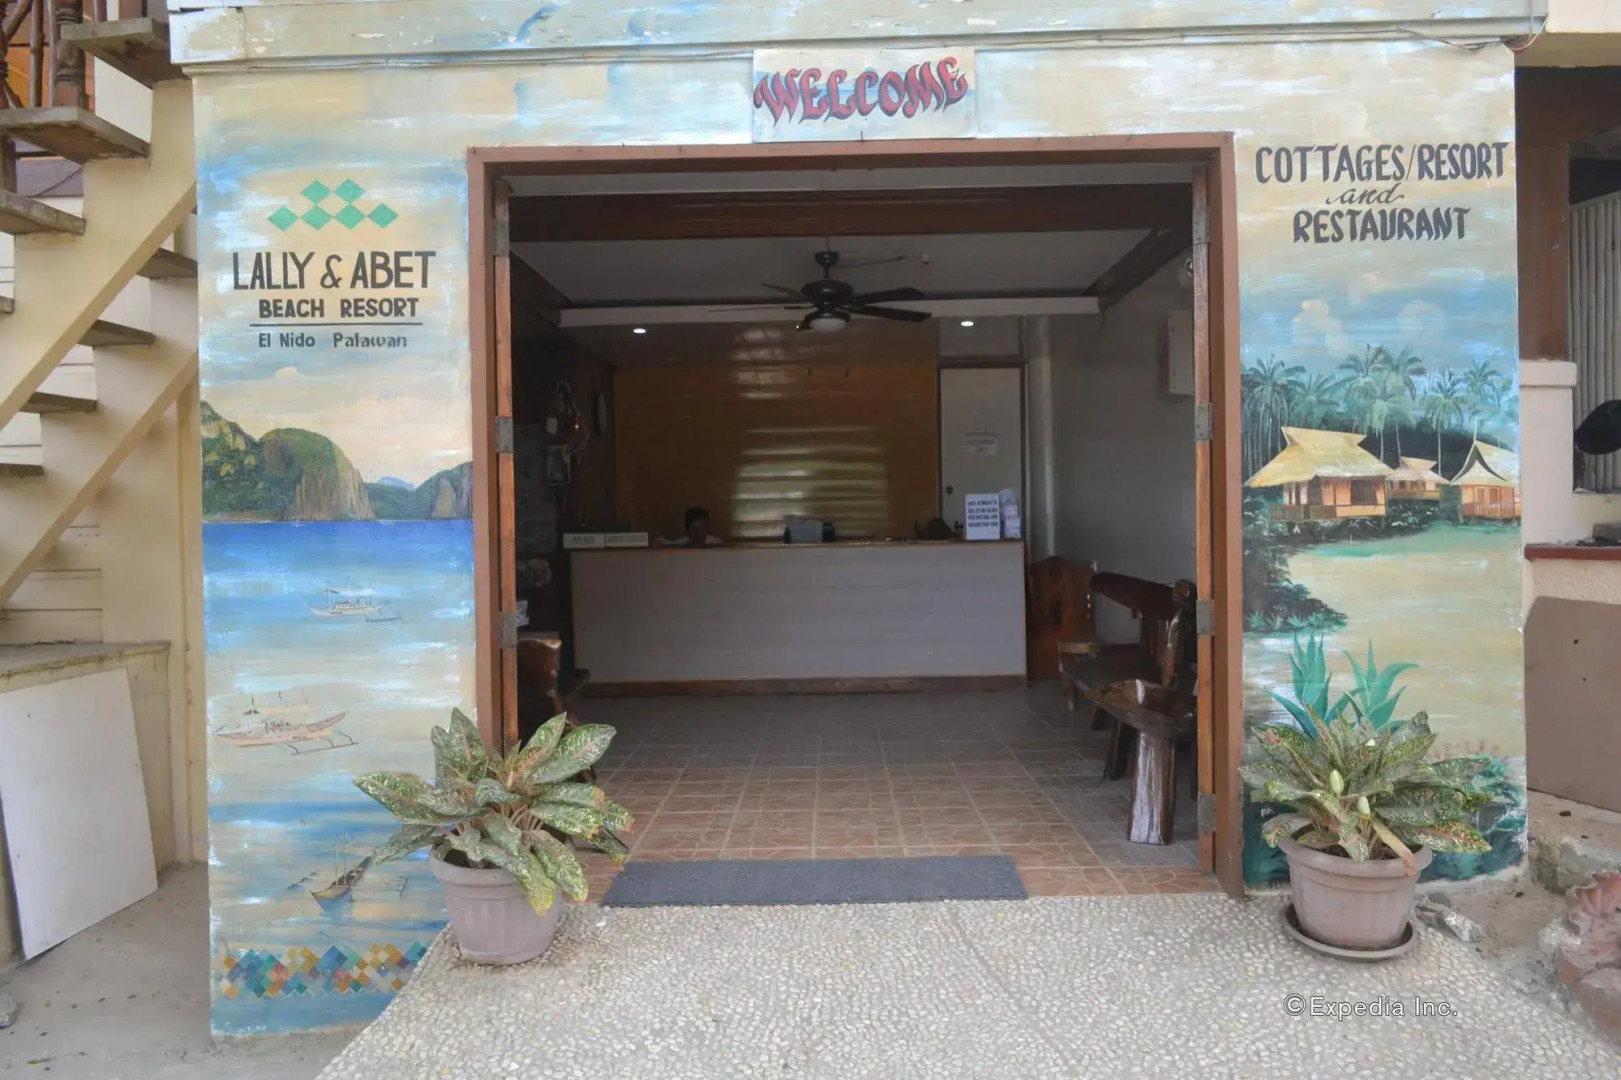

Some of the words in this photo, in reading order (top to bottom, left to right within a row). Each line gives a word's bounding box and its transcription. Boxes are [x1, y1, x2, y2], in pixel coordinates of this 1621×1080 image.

[754, 56, 969, 127] WELCOME
[1325, 182, 1405, 205] and
[1293, 207, 1471, 244] RESTAURANT
[232, 252, 316, 290] LALLY
[320, 254, 343, 289] &
[350, 251, 436, 289] ABET
[259, 299, 325, 318] BEACH
[340, 298, 420, 318] RESORT
[258, 333, 272, 348] El
[279, 333, 316, 348] Nido
[333, 333, 407, 348] Palawan
